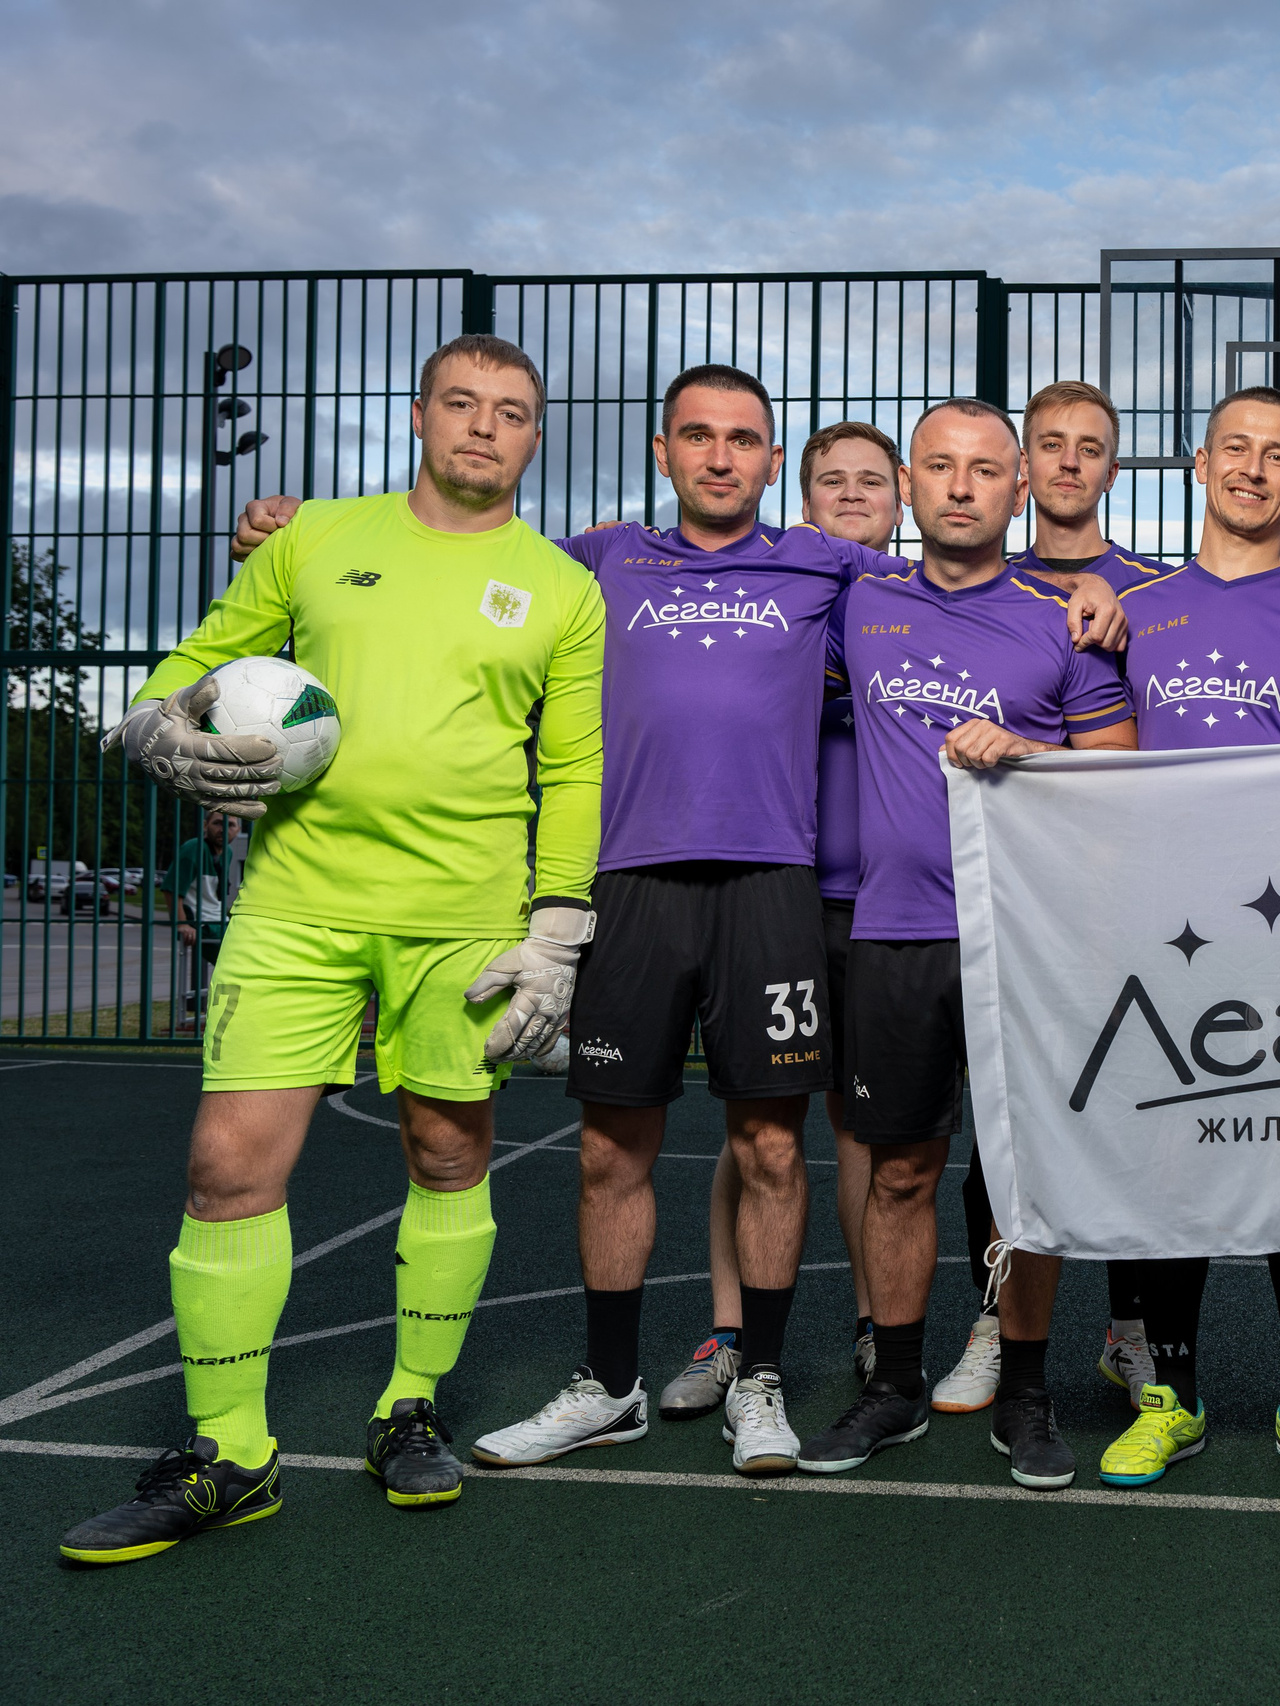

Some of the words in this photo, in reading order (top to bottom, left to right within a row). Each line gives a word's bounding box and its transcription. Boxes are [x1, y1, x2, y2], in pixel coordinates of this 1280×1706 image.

[624, 557, 683, 567] KELME
[862, 625, 911, 634] KELME
[1137, 615, 1189, 638] KELME
[765, 979, 819, 1041] 33
[771, 1050, 821, 1065] KELME
[402, 1308, 473, 1321] INGAM
